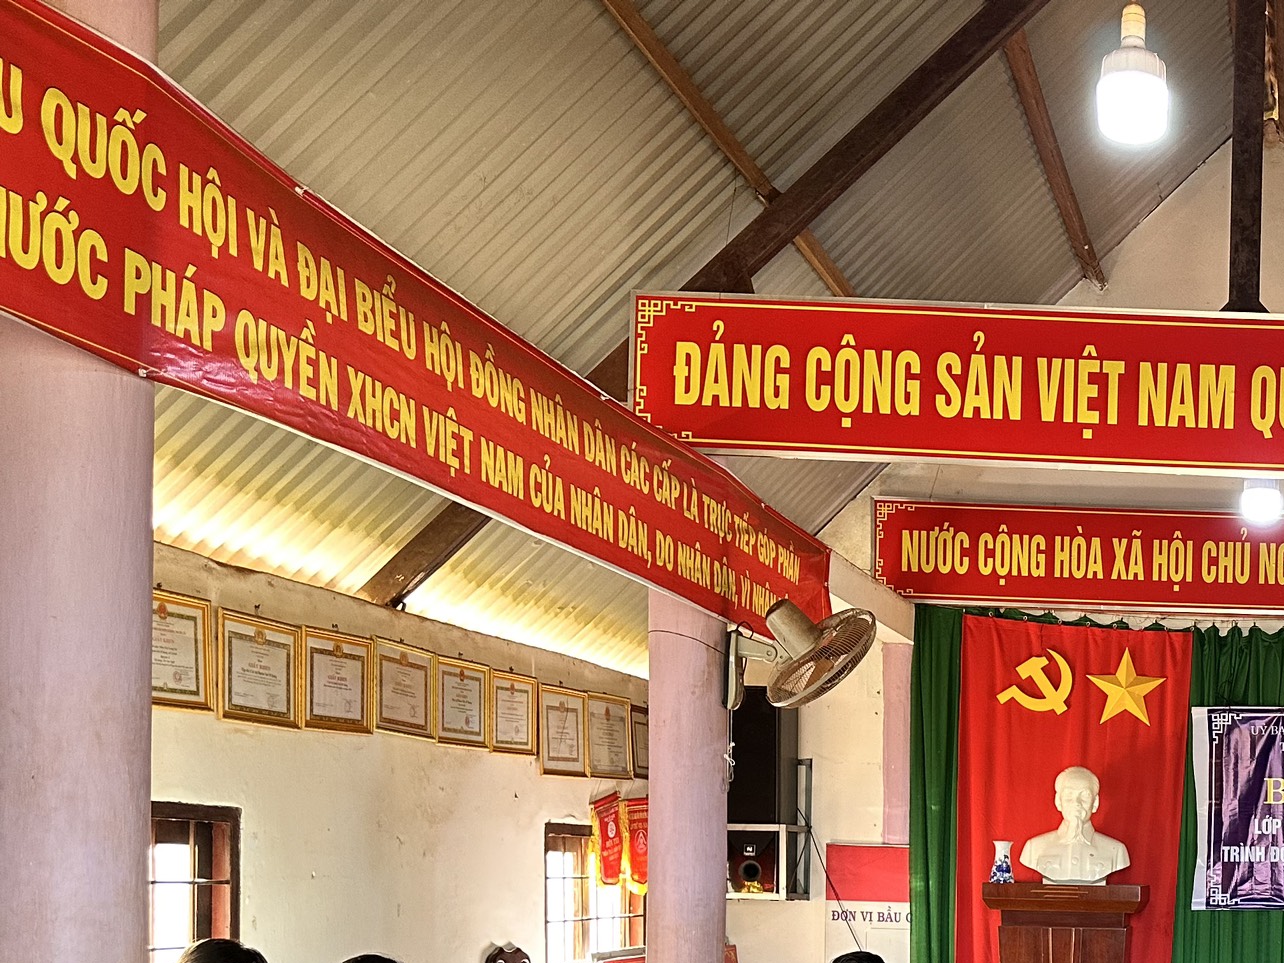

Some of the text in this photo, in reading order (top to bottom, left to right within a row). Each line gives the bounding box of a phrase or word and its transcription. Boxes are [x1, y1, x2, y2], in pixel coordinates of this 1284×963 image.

[40, 87, 167, 212] QUỐC
[178, 163, 238, 258] HỘI
[246, 206, 289, 288] VÀ
[297, 240, 348, 325] ĐẠI
[354, 274, 417, 360] BIỂU
[424, 319, 464, 389] HỘI
[469, 342, 526, 427] ĐỒNG
[529, 387, 580, 456] NHÂN
[584, 419, 617, 477] DÂN
[620, 441, 650, 496] CÁC
[653, 459, 681, 510] CẤP
[683, 477, 699, 523] LÀ
[702, 494, 733, 544] TRỰC
[734, 512, 756, 556] TIẾP
[757, 528, 776, 568] GÓP
[778, 540, 800, 585] PHẦN
[673, 319, 790, 410] ĐẢNG
[805, 334, 921, 428] CỘNG
[935, 331, 1023, 421] SẢN
[1037, 345, 1125, 440] VIỆT
[1138, 361, 1236, 430] NAM
[123, 247, 226, 353] PHÁP
[234, 309, 339, 412] QUYỀN
[346, 364, 416, 448] XHCN
[424, 406, 473, 477] VIỆT
[480, 437, 524, 501] NAM
[529, 454, 565, 521] CỦA
[570, 486, 614, 546] NHÂN
[617, 506, 652, 568] DÂN,
[656, 529, 674, 572] DO
[677, 541, 711, 590] NHÂN
[713, 556, 738, 610] DÂN,
[740, 570, 750, 610] VÌ
[901, 522, 969, 575] NƯỚC
[978, 524, 1046, 586] CỘNG
[1054, 526, 1104, 580] HÒA
[1110, 530, 1144, 581] XÃ
[1152, 530, 1193, 591] HỘI
[1202, 527, 1251, 585] CHỦ
[1222, 843, 1265, 863] TRÌNH
[1254, 815, 1281, 835] LỚP
[831, 909, 856, 921] ĐƠN
[860, 911, 873, 925] VỊ
[877, 905, 902, 923] BẦU
